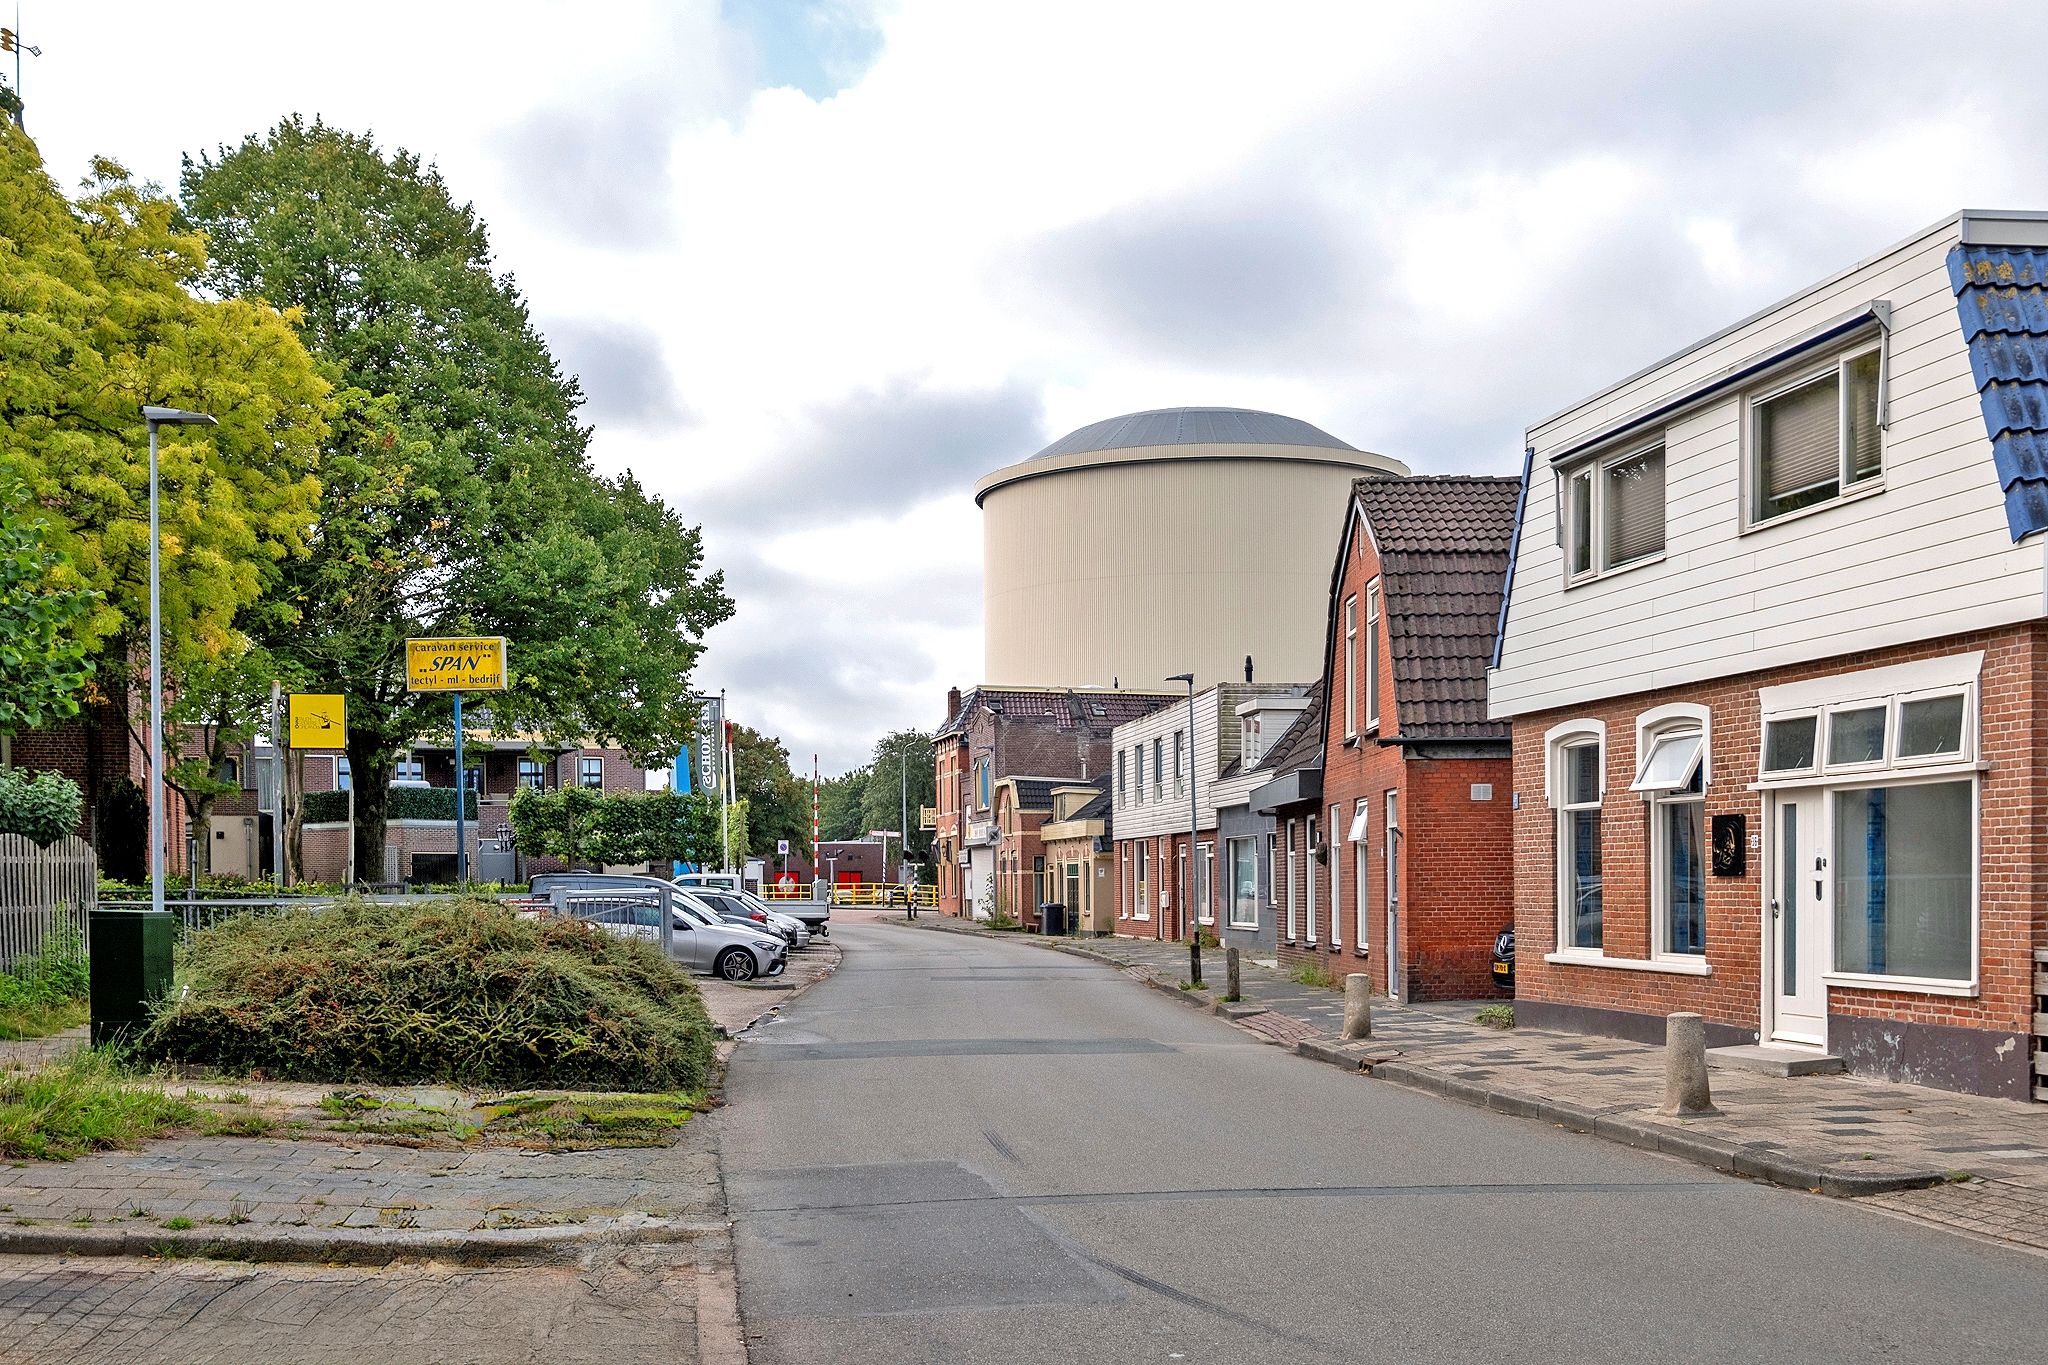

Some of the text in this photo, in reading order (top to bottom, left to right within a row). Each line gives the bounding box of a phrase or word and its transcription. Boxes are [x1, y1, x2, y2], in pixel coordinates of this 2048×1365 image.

[415, 641, 494, 652] caravan service
[411, 675, 437, 686] tectyl
[447, 675, 459, 684] ml
[469, 674, 500, 685] bedrijf
